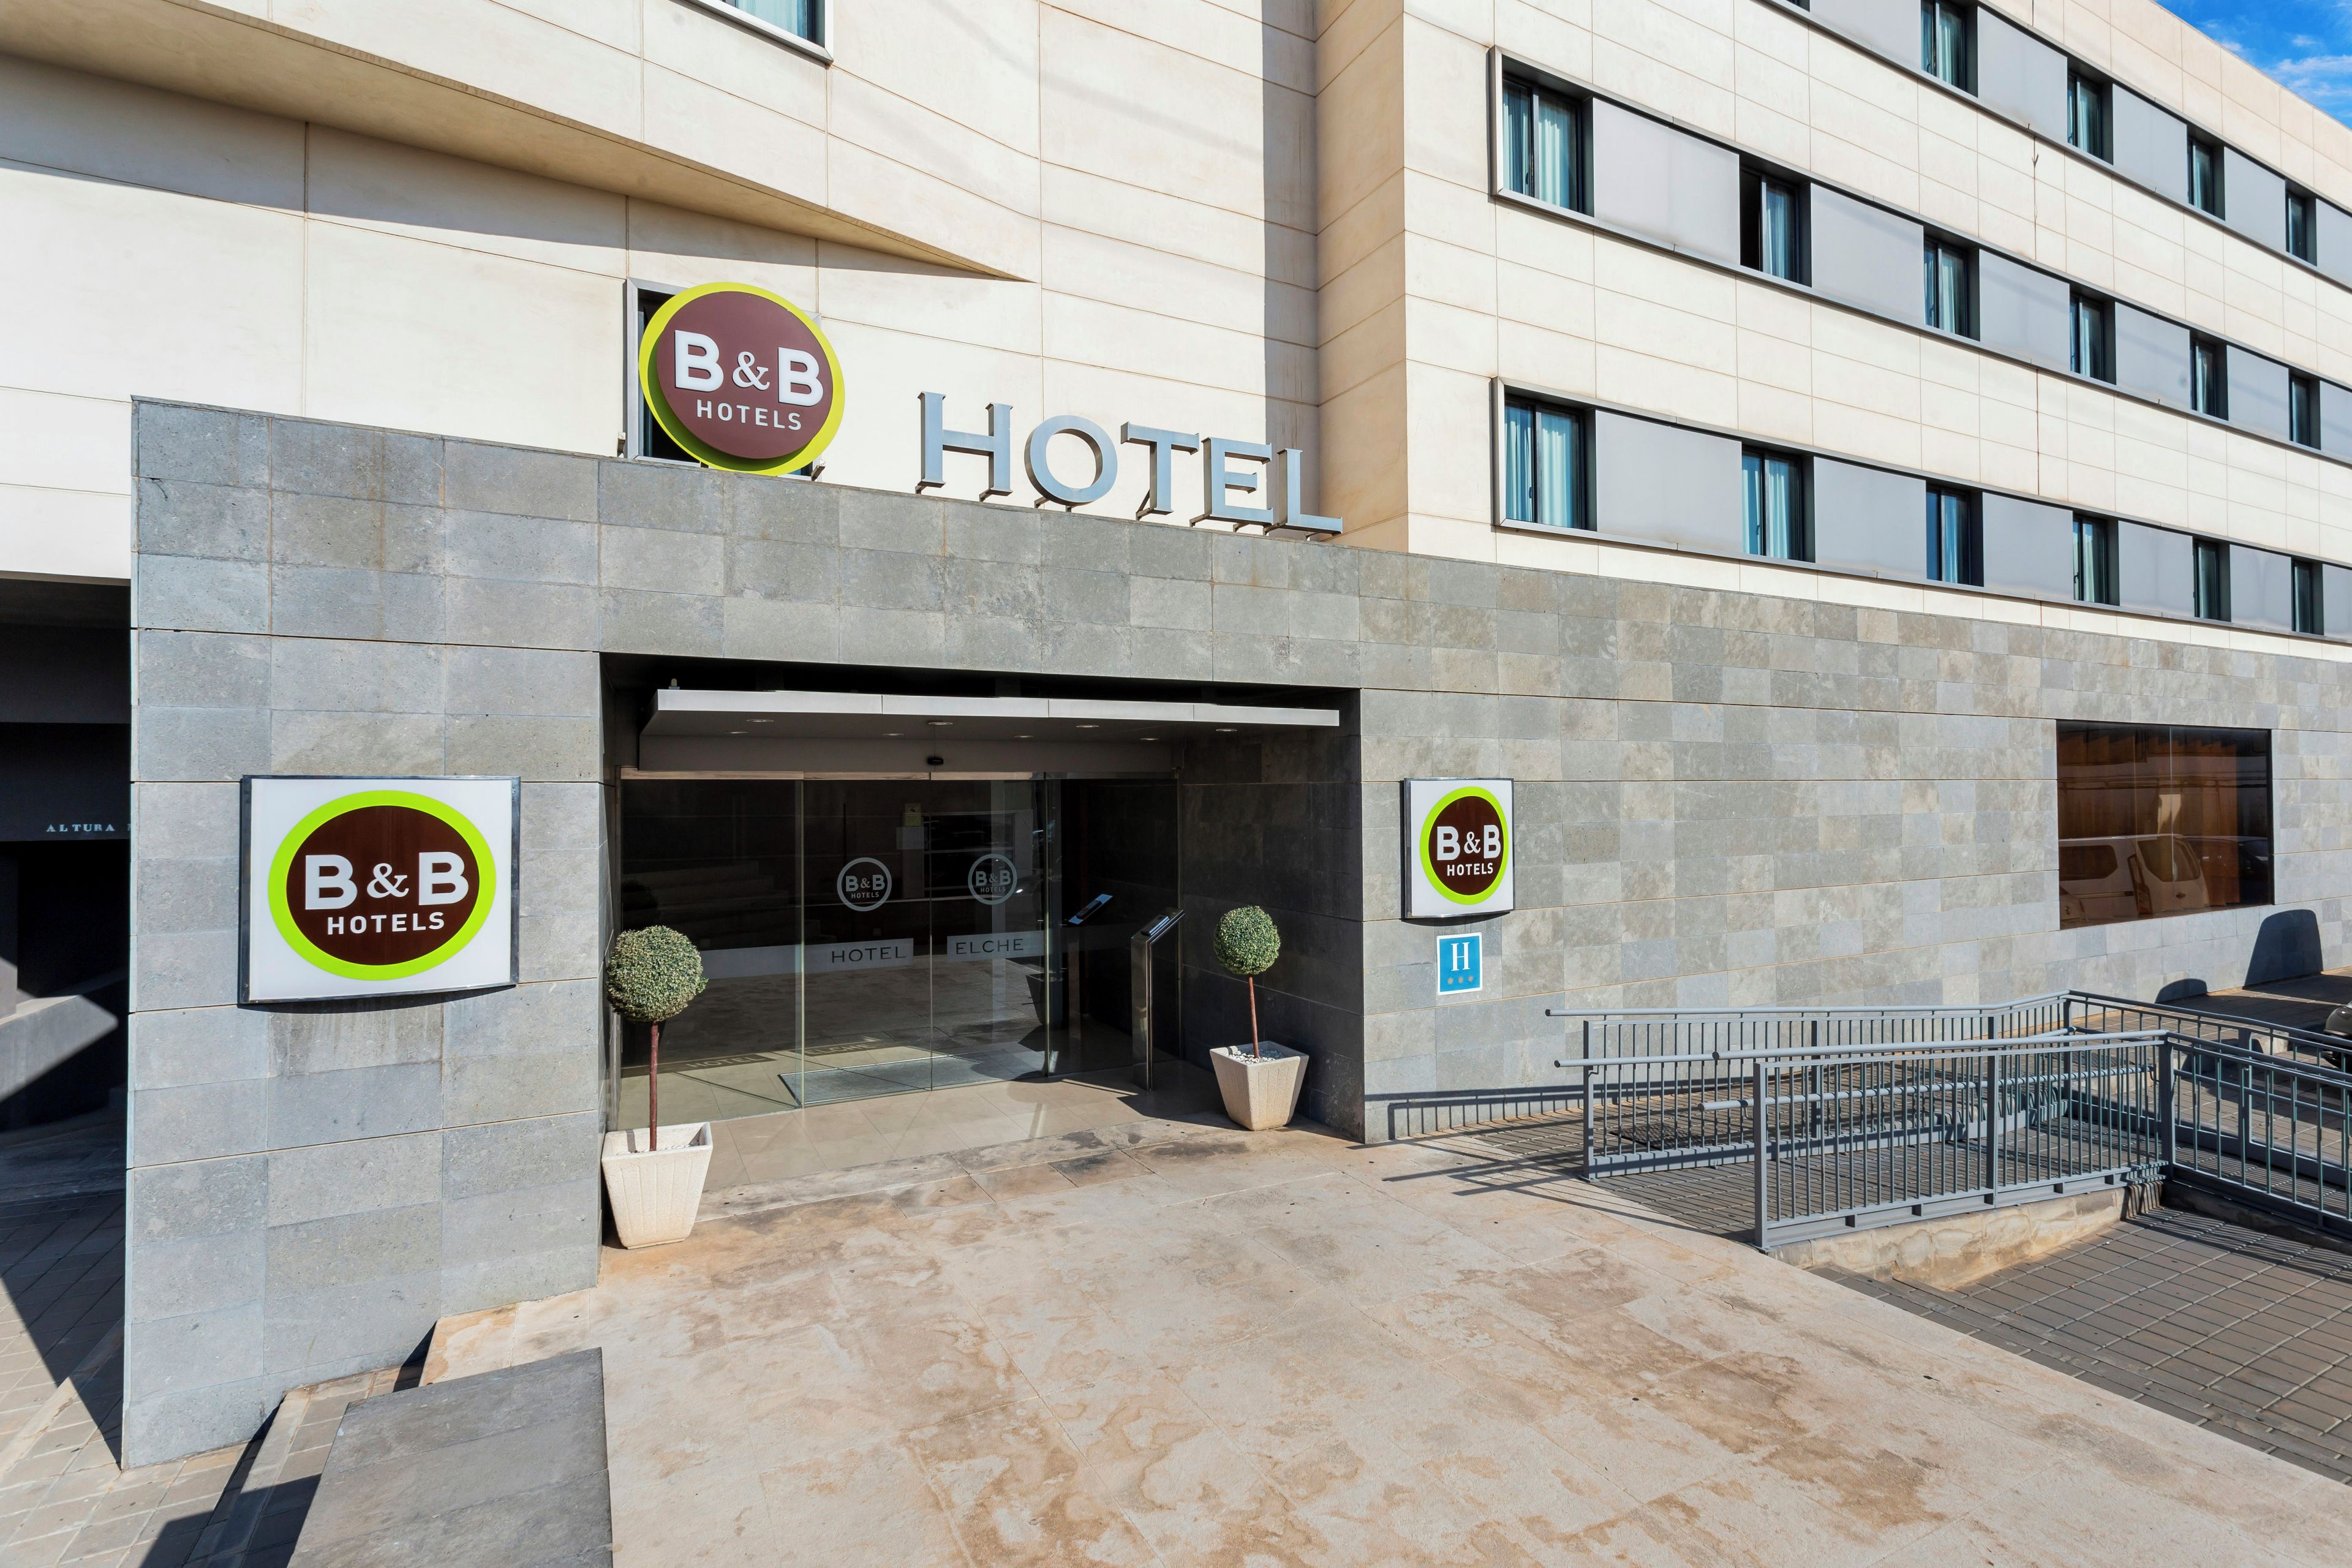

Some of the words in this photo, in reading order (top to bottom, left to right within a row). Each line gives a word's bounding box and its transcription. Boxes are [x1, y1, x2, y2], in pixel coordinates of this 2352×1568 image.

[674, 330, 824, 407] B&B
[696, 399, 802, 431] HOTELS
[917, 391, 1344, 535] HOTEL
[46, 824, 115, 832] ALTURA
[1437, 824, 1501, 861] B&B
[305, 851, 469, 910] B&B
[975, 870, 1011, 887] B&B
[1447, 862, 1493, 876] HOTELS
[845, 874, 885, 892] B&B
[327, 911, 445, 935] HOTELS
[831, 946, 907, 963] HOTEL
[956, 938, 1023, 955] ELCHE
[1450, 942, 1470, 971] H
